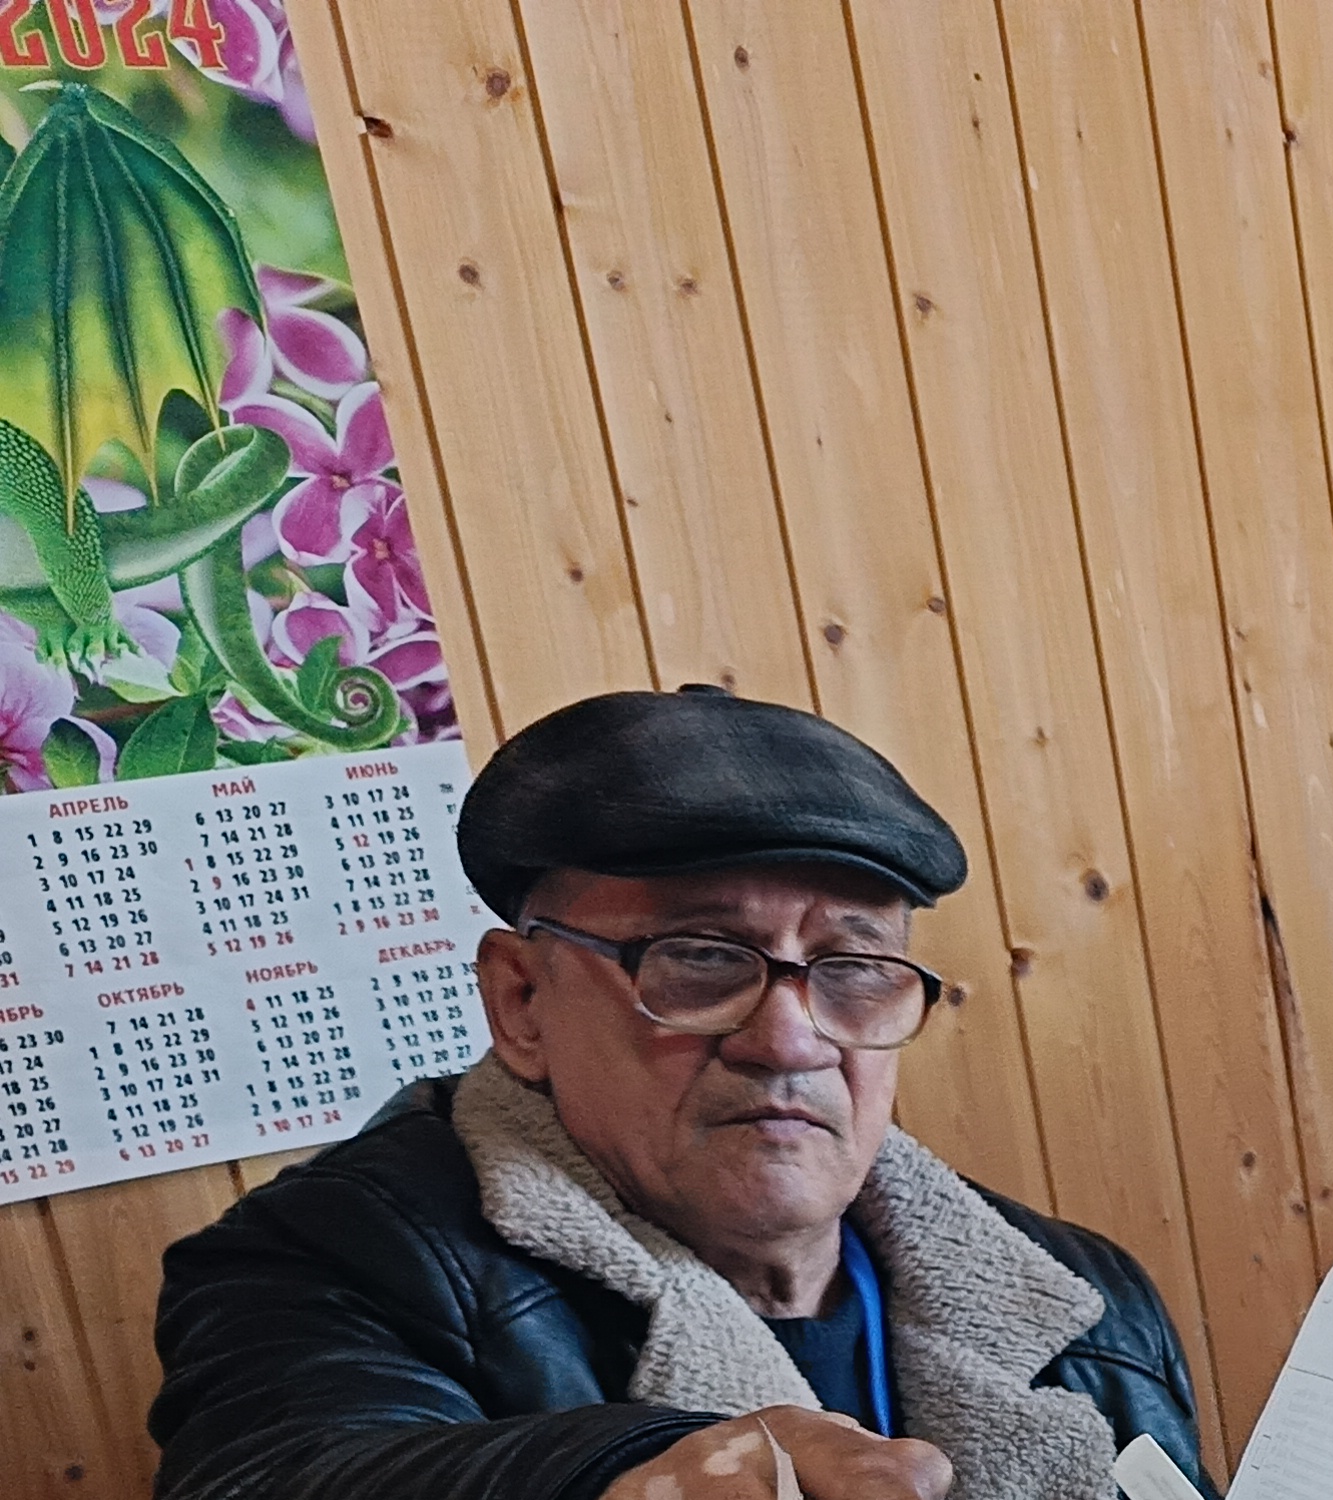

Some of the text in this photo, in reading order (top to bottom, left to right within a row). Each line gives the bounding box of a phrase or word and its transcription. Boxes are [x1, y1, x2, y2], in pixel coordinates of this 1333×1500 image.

[0, 0, 226, 70] 2024
[345, 762, 399, 780] ИЮНЬ
[212, 776, 257, 798] МАЙ
[324, 785, 409, 809] 3 10 17 24
[49, 796, 129, 818] АПРЕЛЬ
[195, 802, 286, 826] 6 13 20 27
[331, 806, 414, 829] 4 11 18 25
[27, 819, 152, 847] 1 8 15 22 29
[200, 823, 293, 847] 7 14 21 28
[335, 827, 420, 851] 5 12 19 26
[33, 841, 157, 870] 2 9 16 23 30
[184, 844, 298, 871] 1 8 15 22 29
[341, 847, 424, 871] 6 13 20 27
[39, 866, 135, 892] 3 10 17 24
[190, 865, 304, 893] 2 9 16 23 30
[346, 868, 430, 892] 7 14 21 28
[47, 887, 141, 913] 4 11 18 25
[196, 886, 309, 915] 3 10 17 24 31
[52, 909, 148, 935] 5 12 19 26
[203, 911, 288, 935] 4 11 18 25
[59, 931, 152, 957] 6 13 20 27
[207, 930, 294, 956] 5 12 19 26
[65, 951, 159, 978] 7 14 21 28
[245, 961, 319, 984] НОЯБРЬ
[97, 982, 185, 1008] ОКТЯБРЬ
[106, 1007, 205, 1035] 7 14 21 28
[17, 1030, 64, 1049] 23 30
[89, 1028, 210, 1060] 1 8 15 22 29
[23, 1055, 44, 1071] 24
[94, 1048, 215, 1081] 2 9 16 23 30
[1, 1076, 49, 1096] 18 25
[100, 1069, 220, 1101] 3 10 17 24 31
[7, 1096, 56, 1117] 19 26
[107, 1093, 198, 1121] 4 11 18 25
[14, 1118, 60, 1138] 20 27
[112, 1113, 204, 1142] 5 12 19 26
[21, 1139, 68, 1159] 21 28
[119, 1134, 209, 1161] 6 13 20 27
[0, 1159, 75, 1184] 15 22 29
